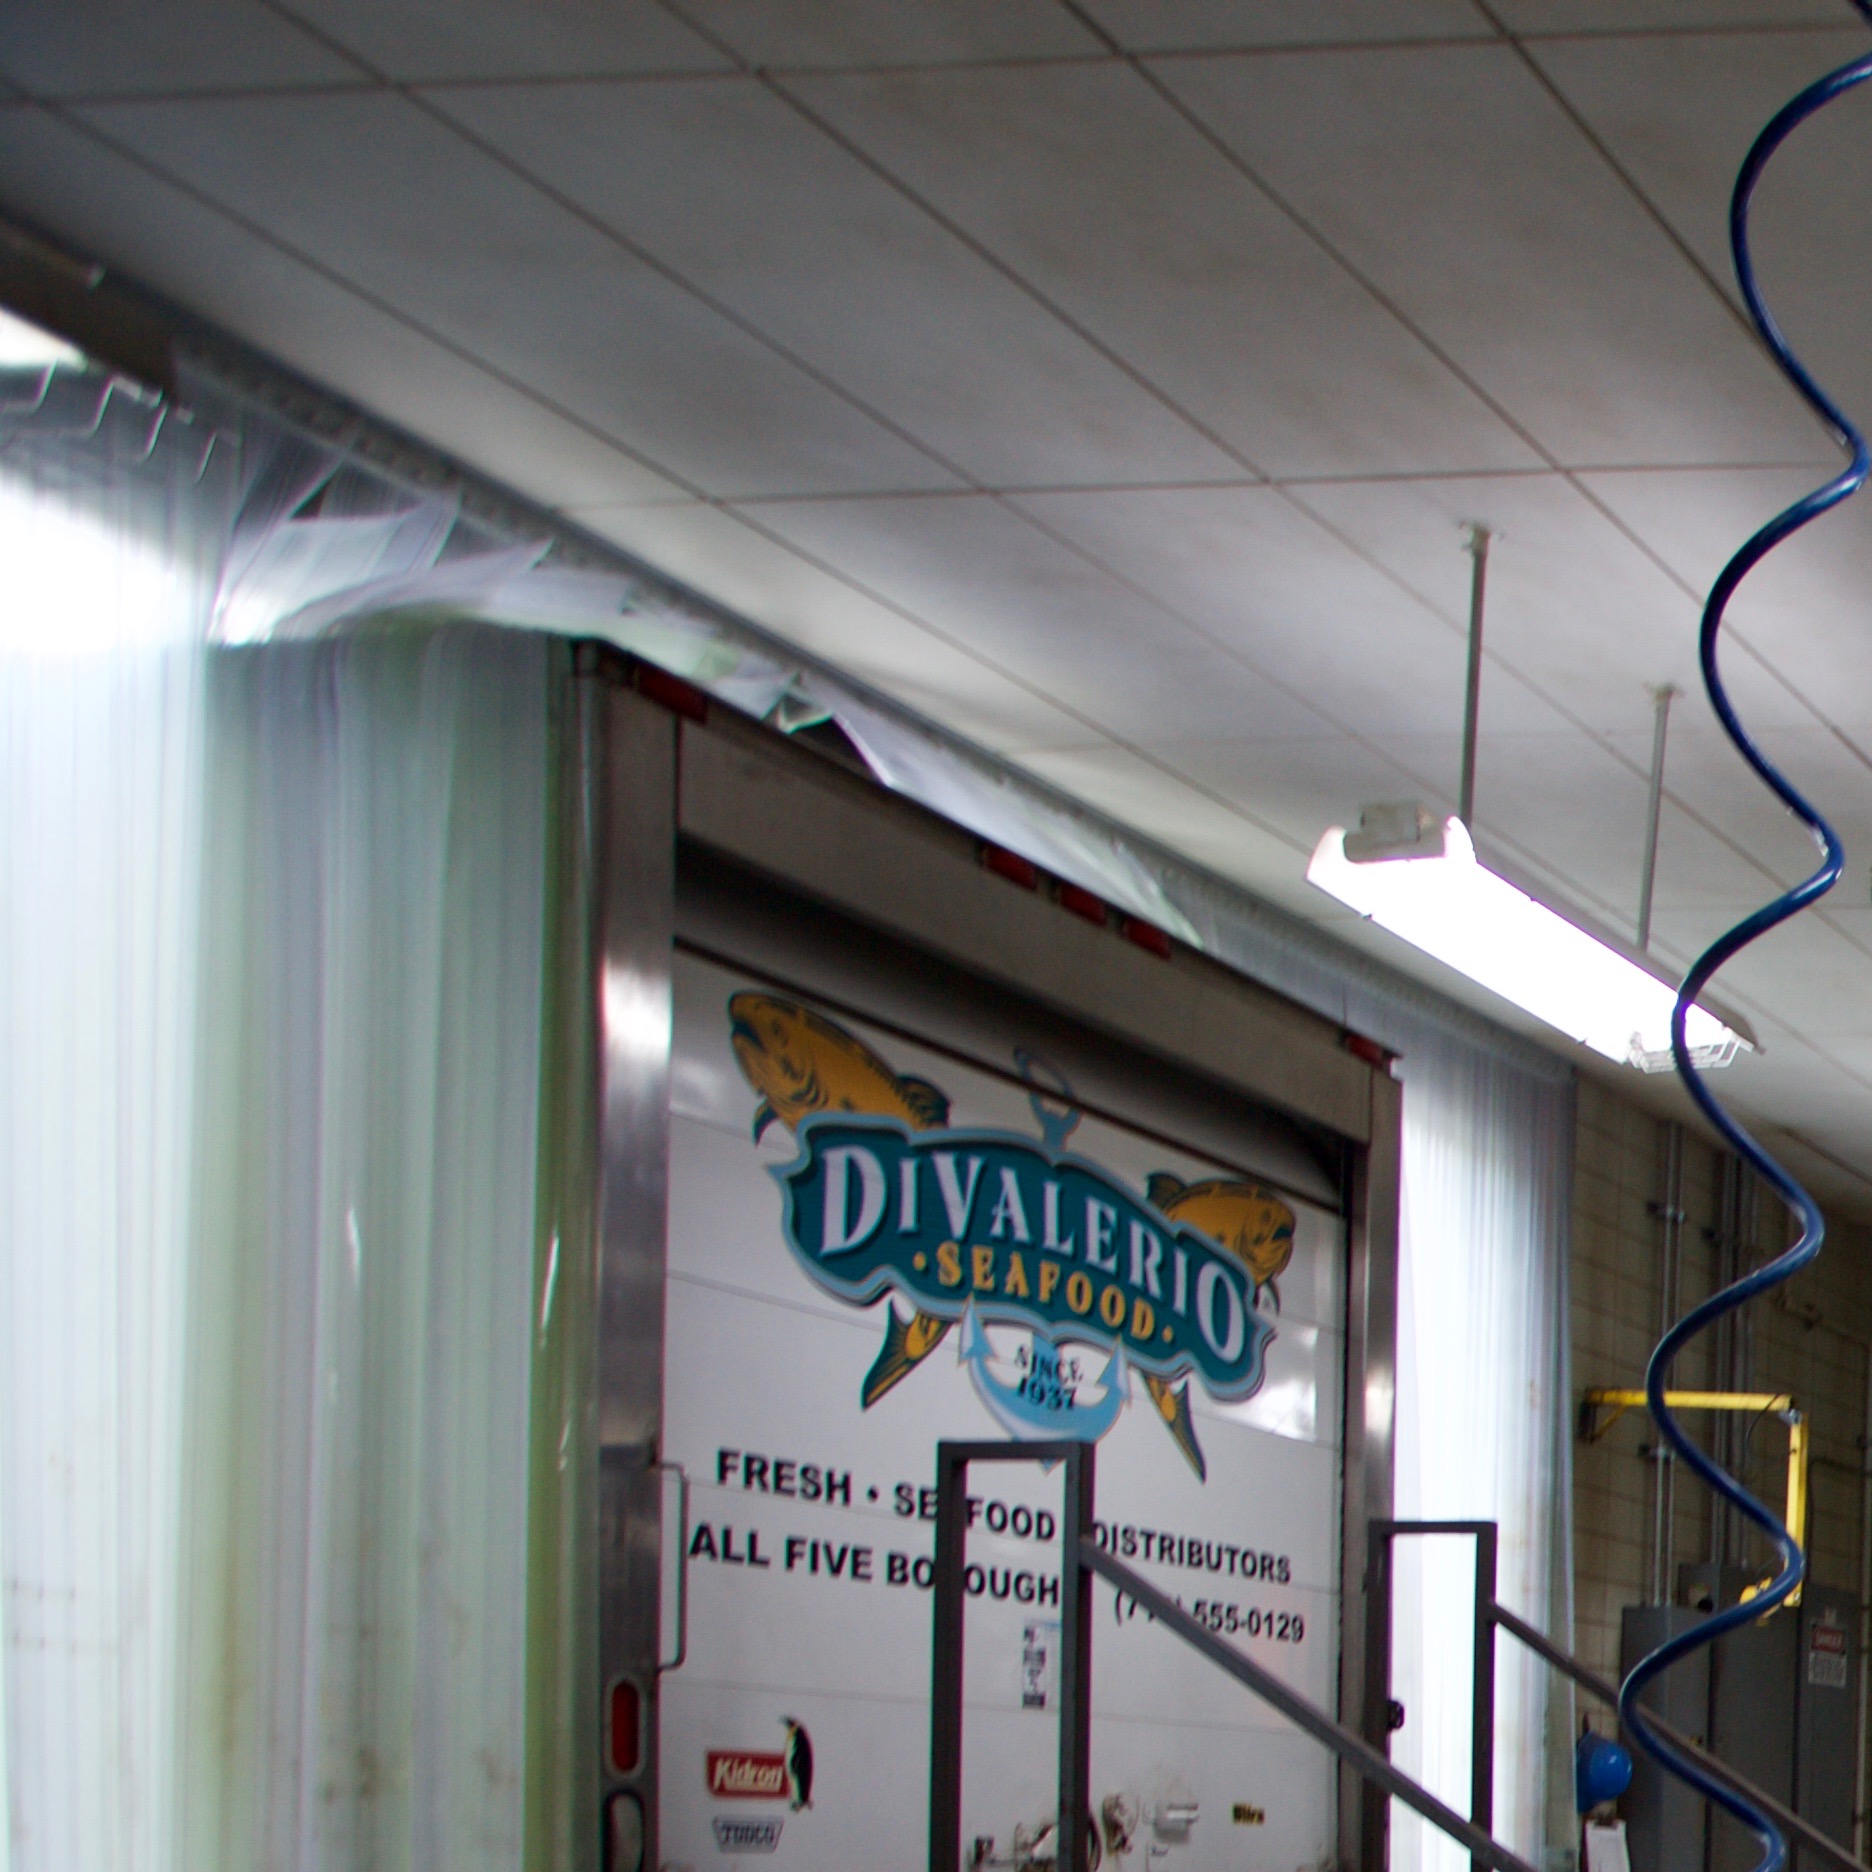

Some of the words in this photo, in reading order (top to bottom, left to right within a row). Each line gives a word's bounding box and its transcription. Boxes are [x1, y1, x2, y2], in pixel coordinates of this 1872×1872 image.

[819, 1144, 1246, 1363] DIVALERIO
[936, 1241, 1156, 1344] SEAFOOD
[1014, 1345, 1084, 1384] SINCE
[1018, 1377, 1078, 1411] 1937
[717, 1447, 852, 1506] FRESH
[894, 1483, 1056, 1541] SEFOOD
[1093, 1521, 1292, 1585] DISTRIBUTORS
[690, 1522, 770, 1567] ALL
[785, 1535, 873, 1582] FIVE
[886, 1552, 1059, 1606] BOOUGH
[1193, 1597, 1305, 1644] 555-0129
[714, 1758, 783, 1793] Kidron
